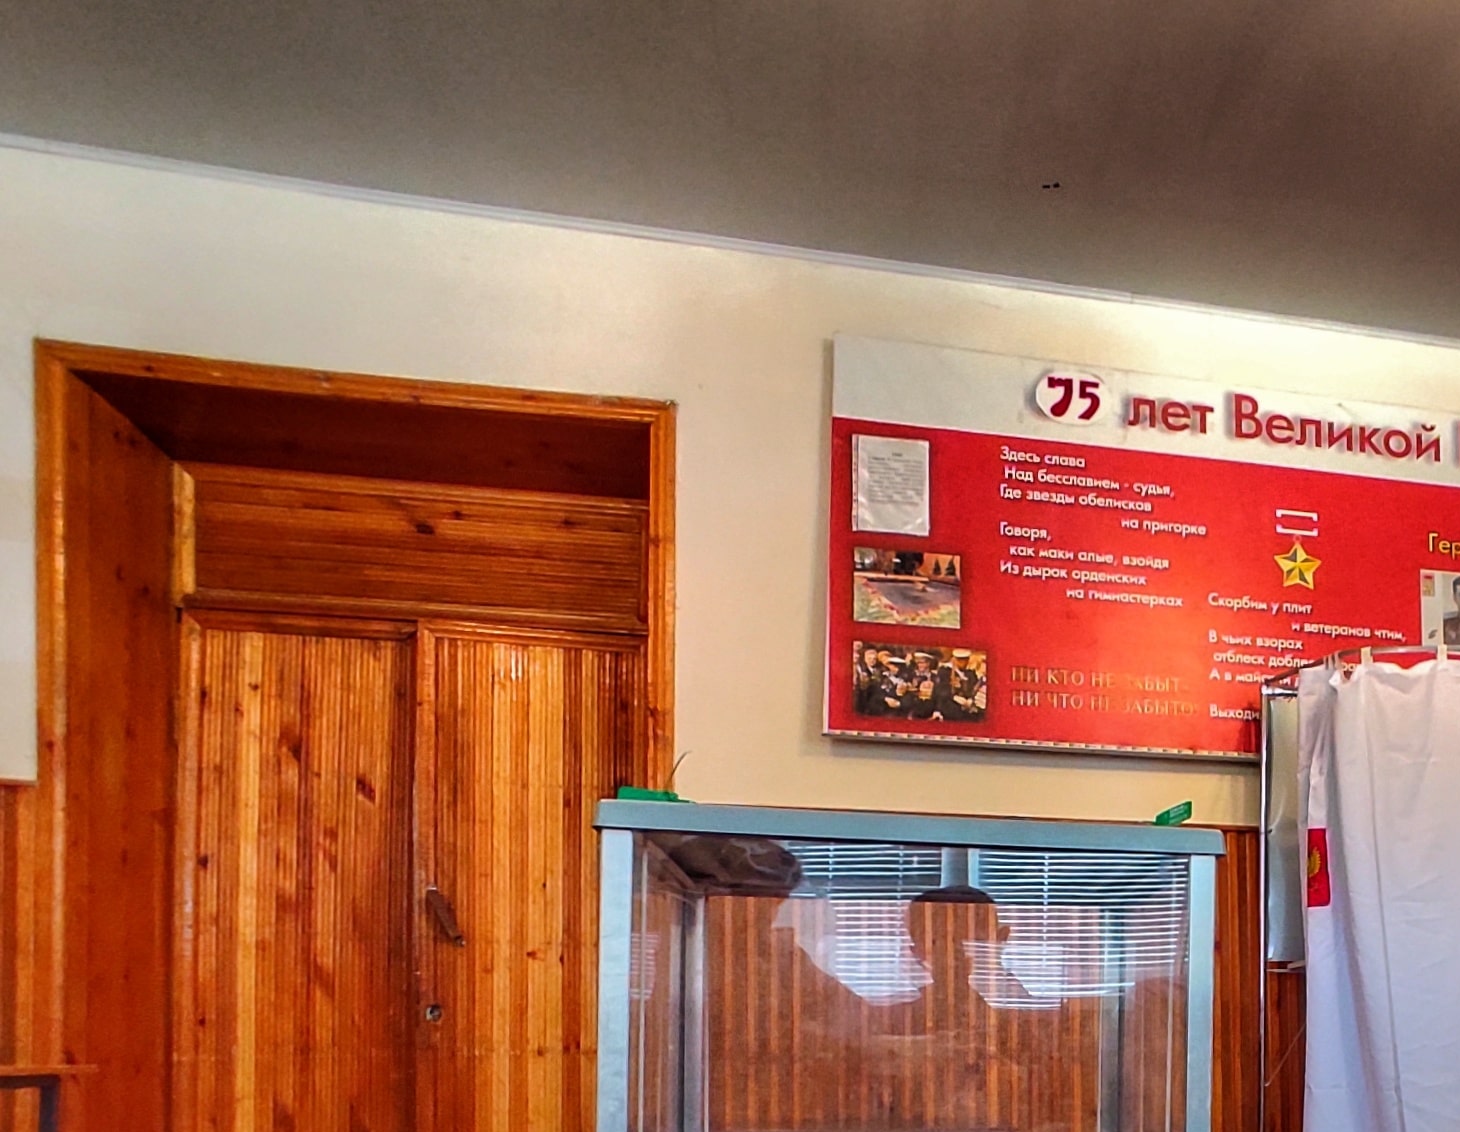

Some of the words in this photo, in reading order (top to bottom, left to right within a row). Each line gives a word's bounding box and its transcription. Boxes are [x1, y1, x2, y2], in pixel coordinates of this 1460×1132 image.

[1046, 375, 1101, 421] 75
[1127, 396, 1215, 435] лет
[1233, 392, 1441, 462] Великой
[1000, 445, 1041, 464] Здесь
[1044, 454, 1086, 468] слава
[1004, 465, 1034, 484] Над
[1037, 468, 1120, 491] бесславием
[1000, 483, 1022, 500] Где
[1026, 489, 1075, 505] звезды
[1079, 492, 1152, 513] обелисков
[1000, 521, 1052, 542] Говоря,
[1121, 518, 1140, 530] на
[1142, 519, 1207, 538] пригорке
[1009, 544, 1035, 557] как
[1039, 548, 1074, 561] маки
[1122, 553, 1170, 570] взойдя
[1000, 560, 1020, 576] Из
[1023, 564, 1068, 580] дырок
[1071, 567, 1147, 586] орденских
[1066, 588, 1085, 600] на
[1208, 592, 1268, 612] Скорбим
[1271, 602, 1279, 615] у
[1282, 603, 1313, 615] плит
[1208, 629, 1218, 644] В
[1221, 634, 1252, 647] чьих
[1256, 635, 1304, 652] взорах
[1291, 621, 1300, 632] и
[1303, 622, 1371, 639] ветеранов
[1212, 649, 1266, 666] отблеск
[1047, 667, 1085, 687] КТО
[1208, 667, 1221, 681] А
[1224, 671, 1232, 682] в
[1047, 692, 1084, 711] ЧТО
[1209, 704, 1263, 721] Выходи
